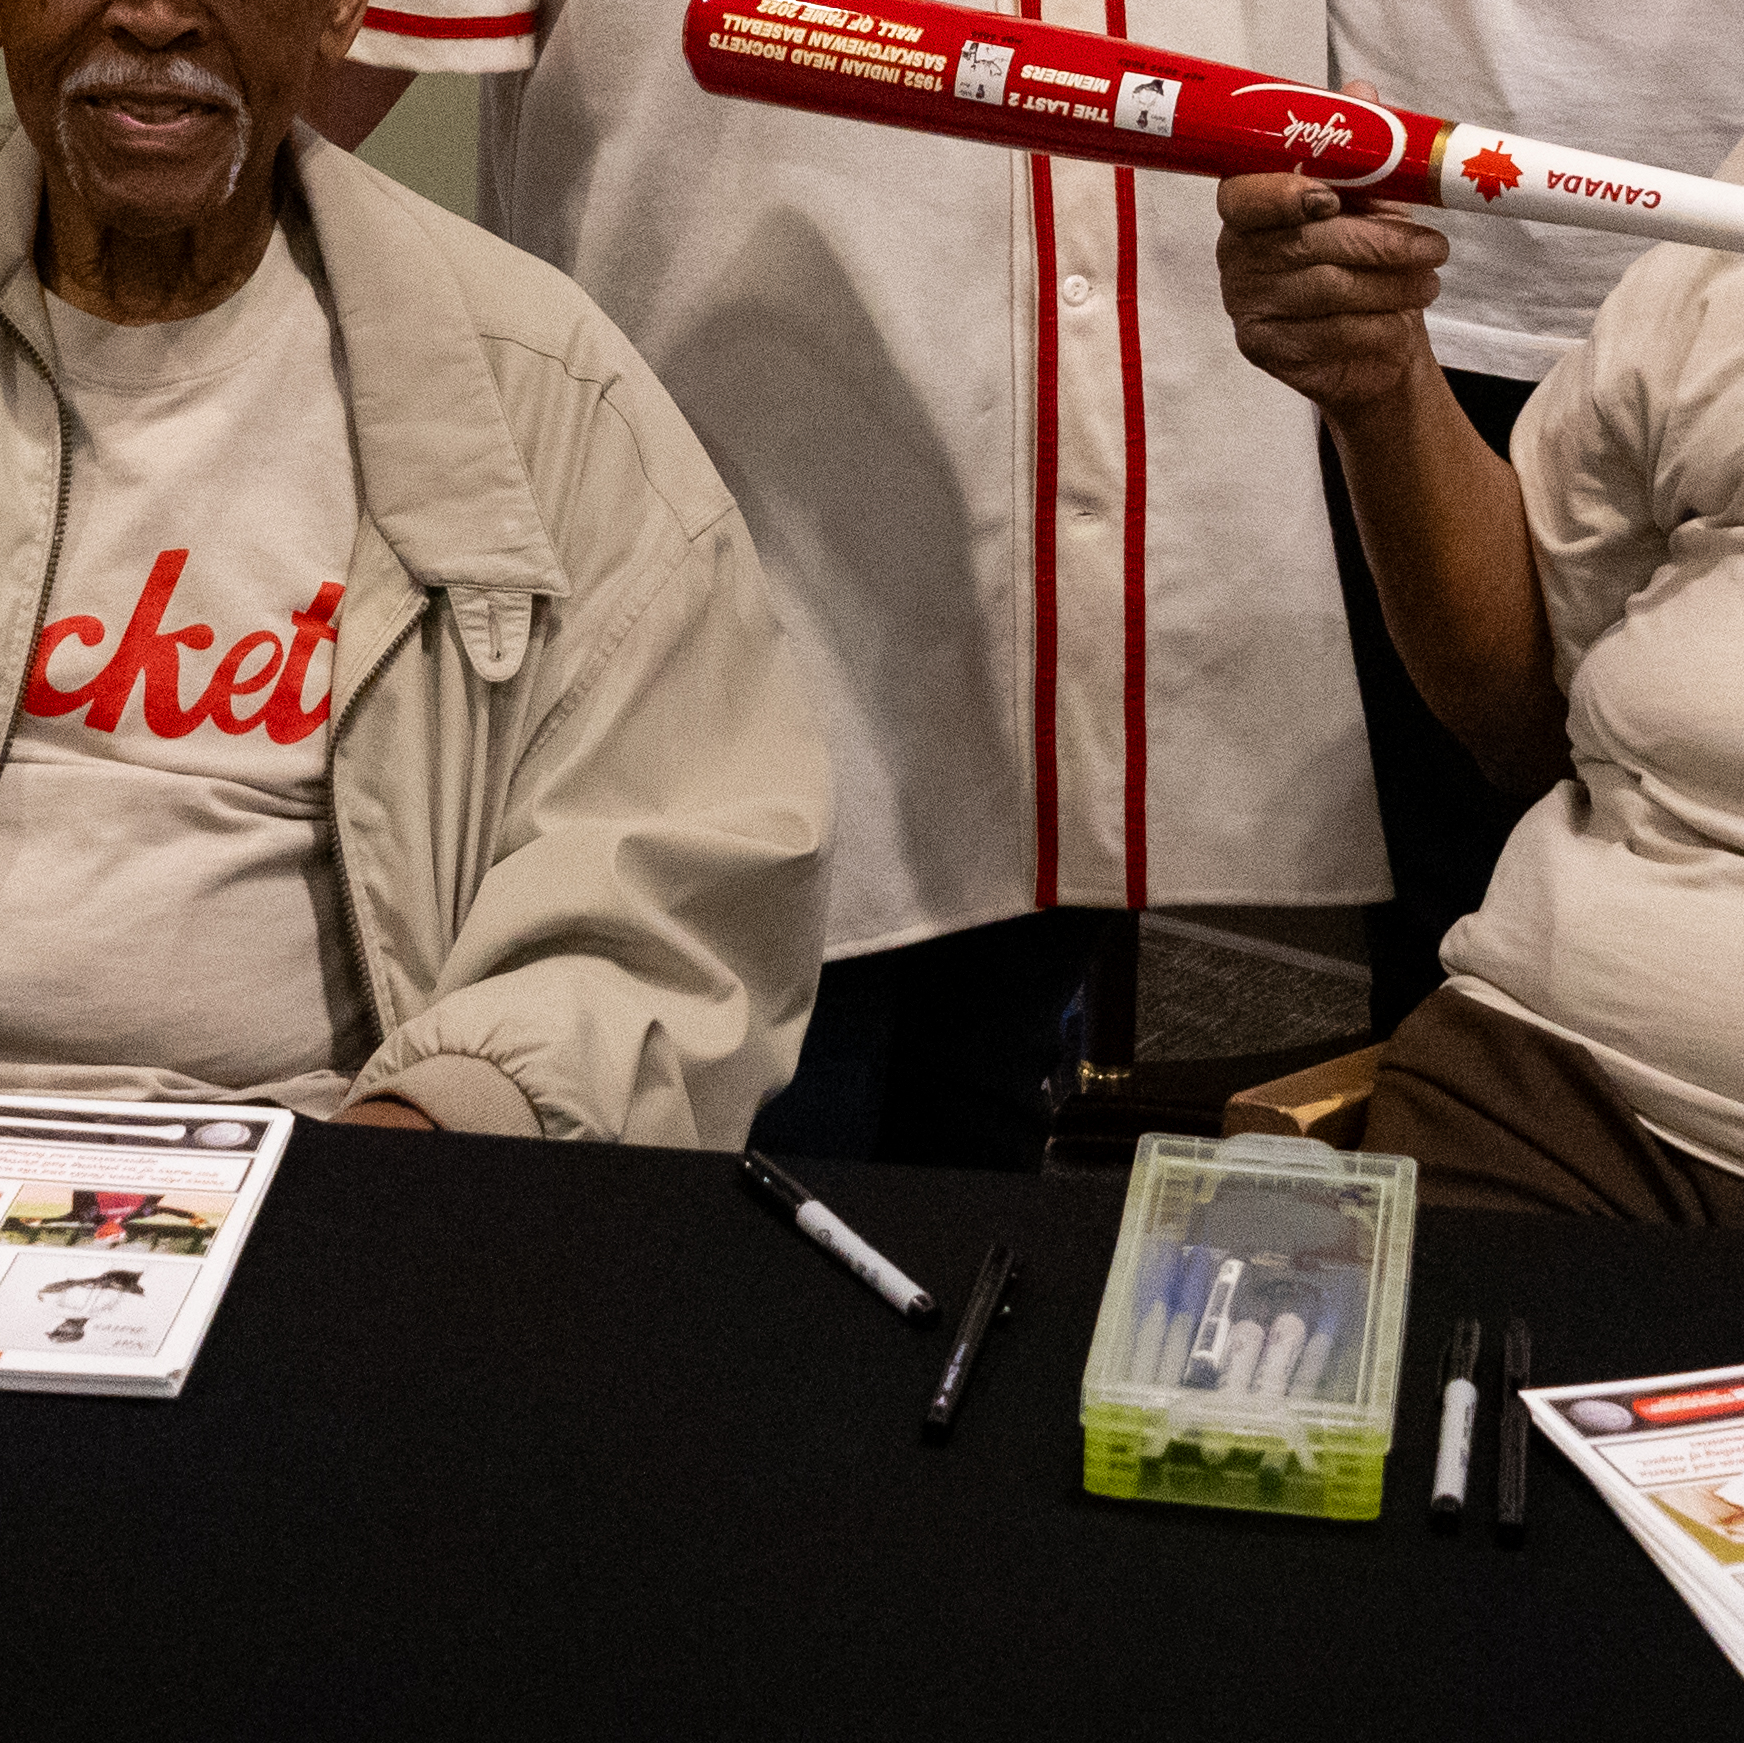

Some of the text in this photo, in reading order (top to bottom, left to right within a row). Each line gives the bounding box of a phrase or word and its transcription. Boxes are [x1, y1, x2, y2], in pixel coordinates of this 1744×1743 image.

[798, 7, 849, 29] FAME
[878, 20, 924, 42] HALL
[708, 33, 788, 62] ROCKETS
[723, 13, 947, 72] SASKATCHEWAN BASEBALL
[791, 48, 838, 72] HEAD
[840, 58, 901, 83] INDIAN
[904, 71, 943, 92] 1952
[1021, 64, 1111, 94] MEMBERS
[1008, 92, 1109, 123] THE LAST 2
[1547, 169, 1662, 209] CANADA
